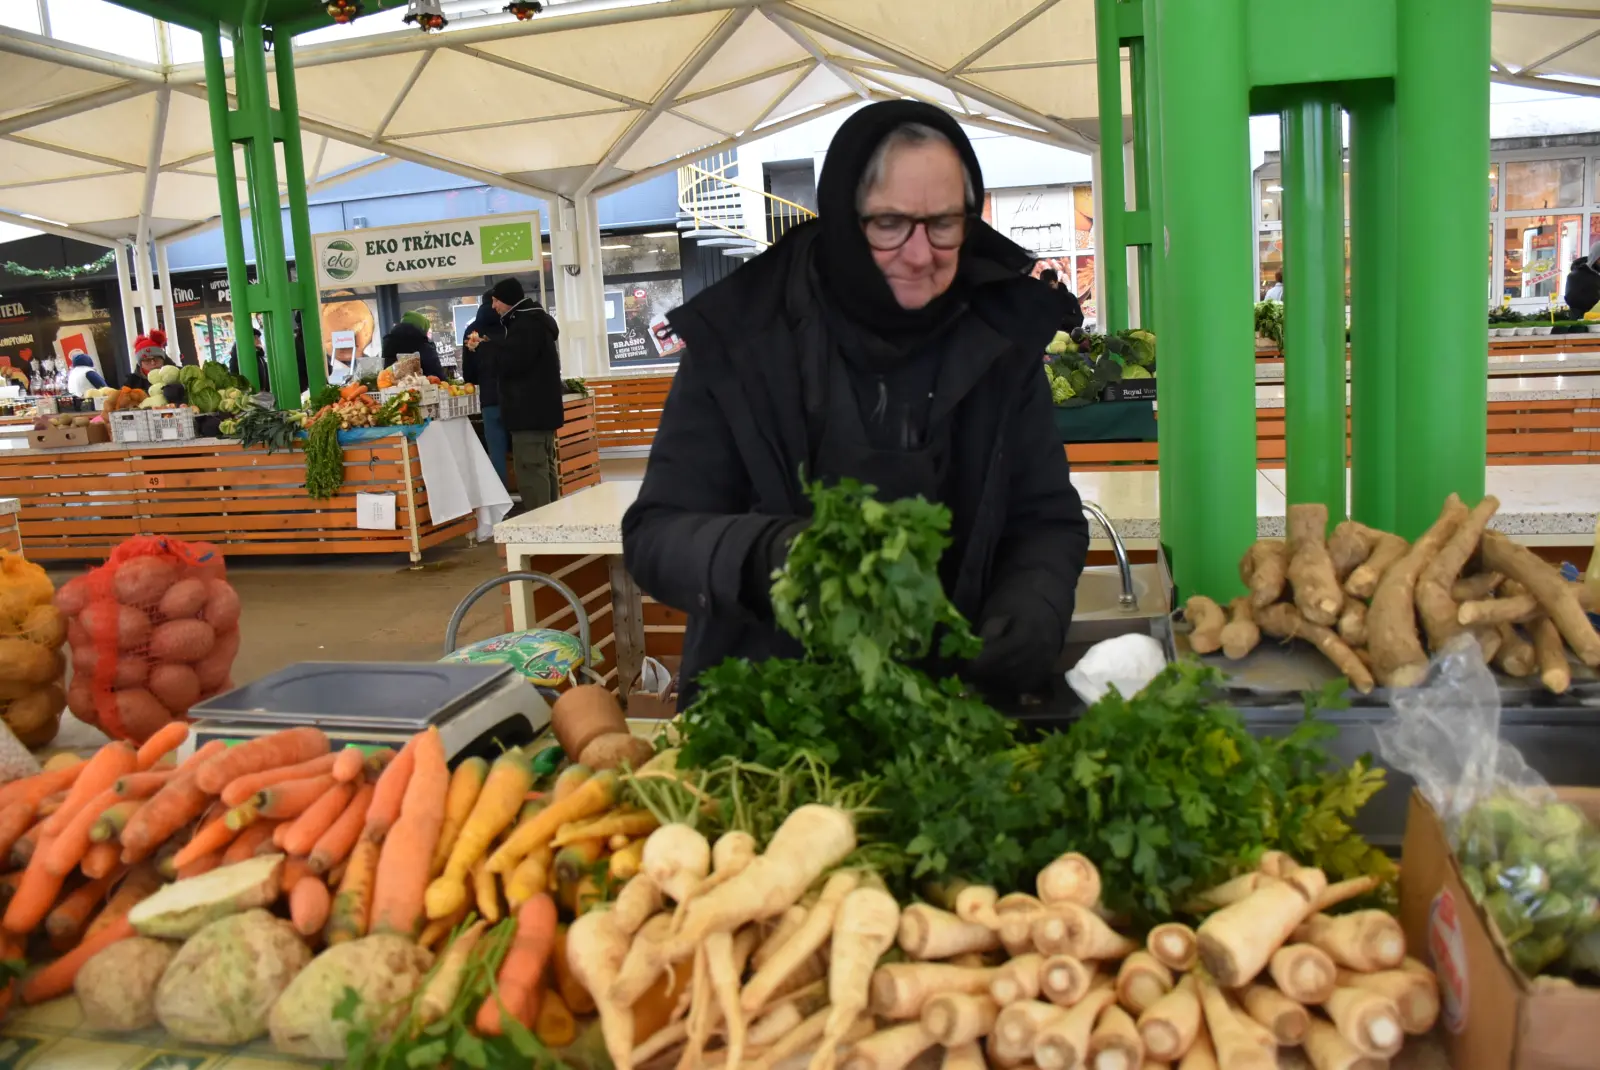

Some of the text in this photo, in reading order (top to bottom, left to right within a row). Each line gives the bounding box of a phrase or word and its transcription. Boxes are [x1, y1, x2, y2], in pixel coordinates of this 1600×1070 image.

[365, 238, 398, 256] EKO
[402, 230, 475, 252] TRŽNICA
[327, 251, 353, 268] eko
[385, 255, 457, 273] ČAKOVEC
[0, 302, 31, 318] TETA...
[613, 338, 645, 349] BRAŠNO
[149, 477, 159, 486] 49
